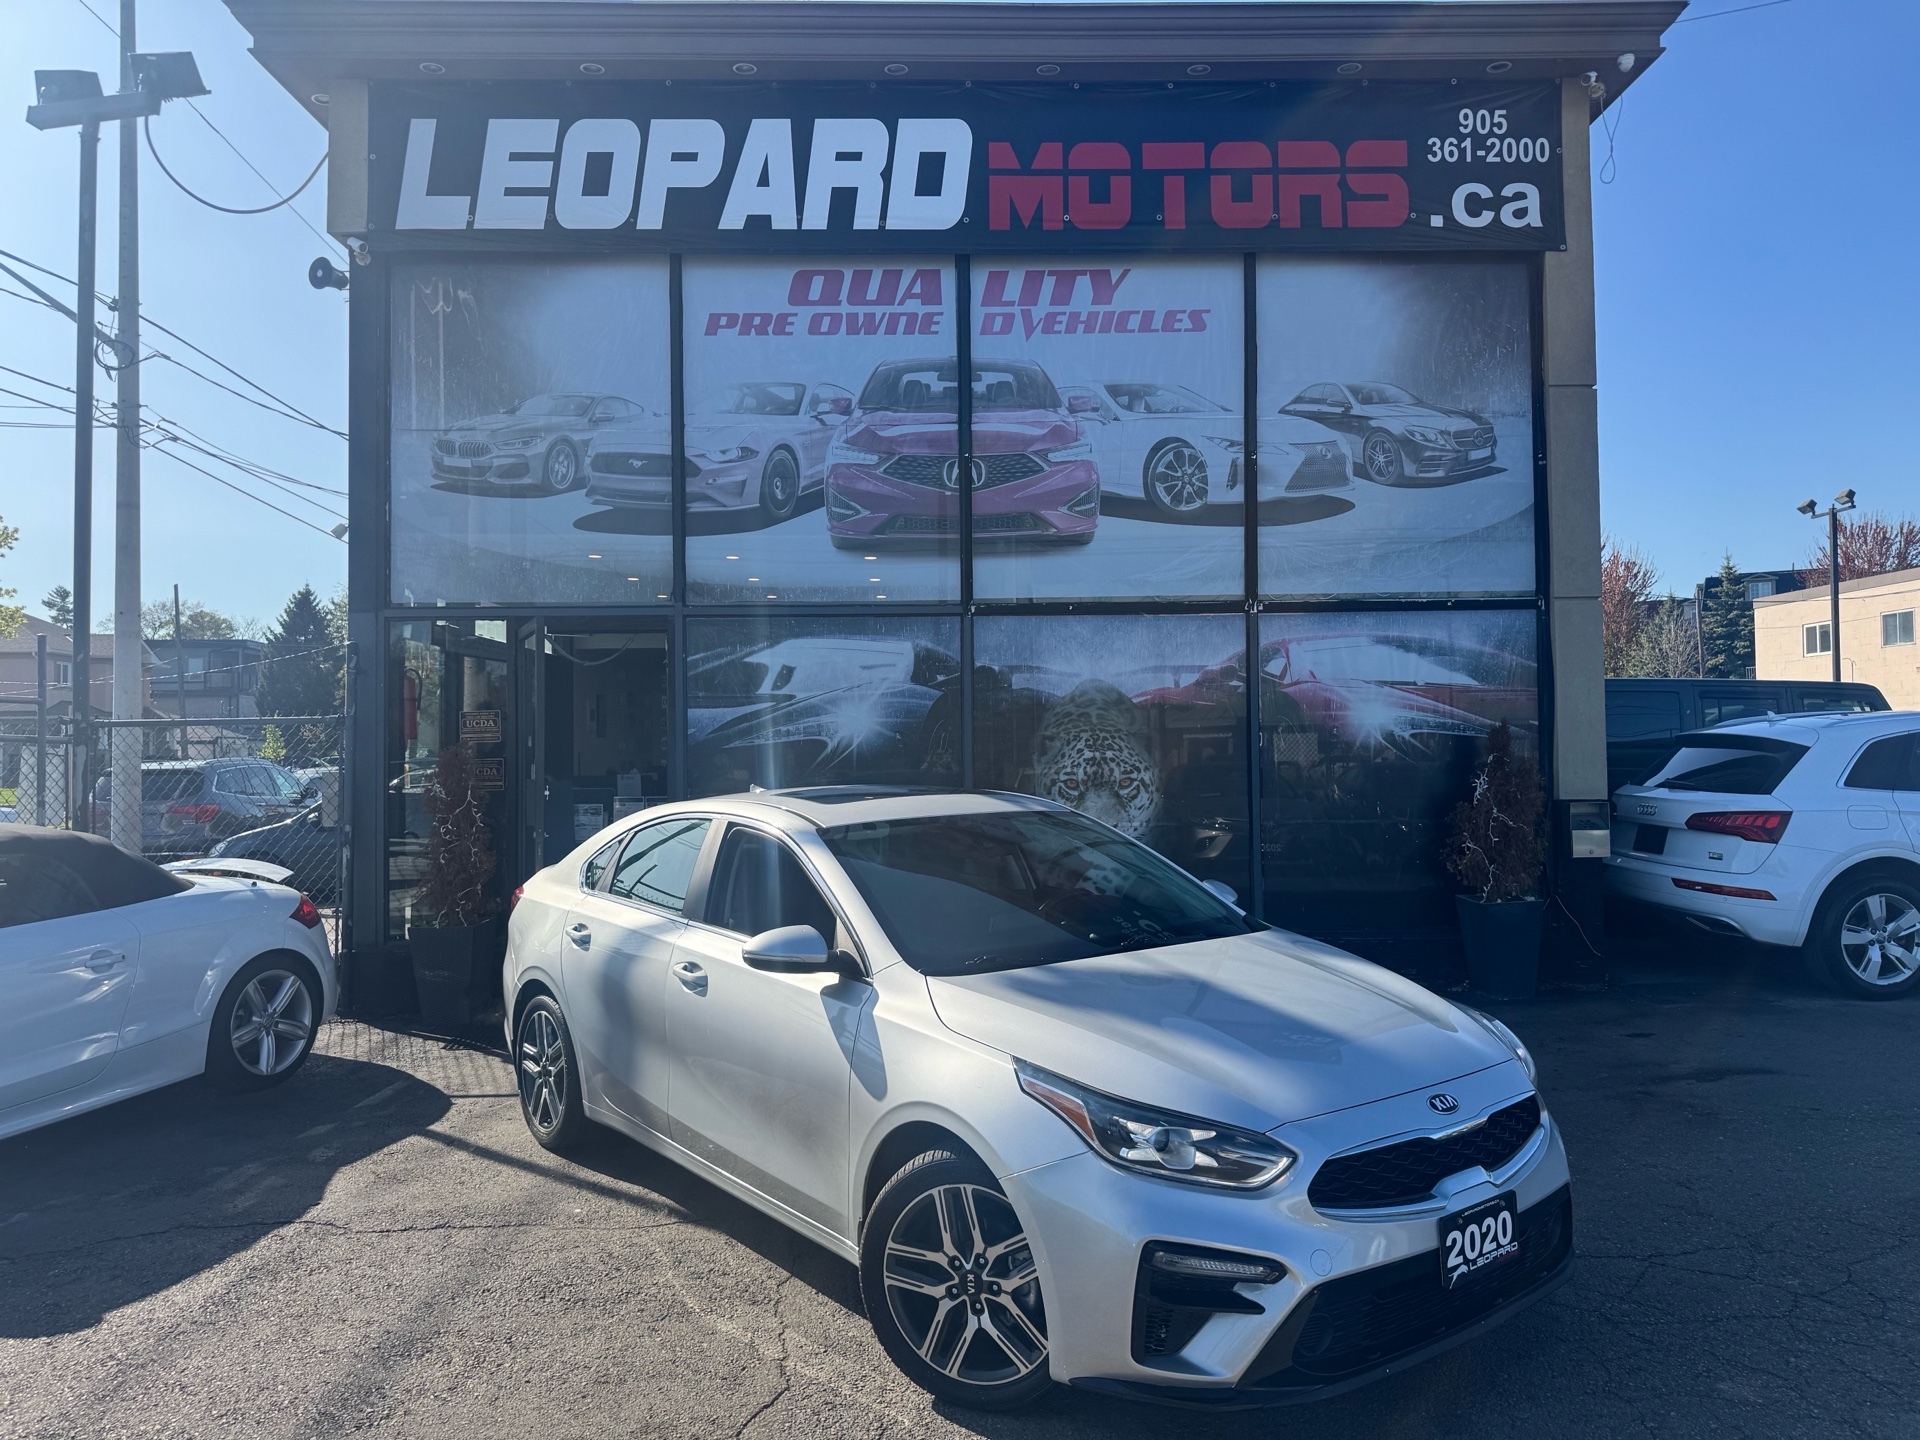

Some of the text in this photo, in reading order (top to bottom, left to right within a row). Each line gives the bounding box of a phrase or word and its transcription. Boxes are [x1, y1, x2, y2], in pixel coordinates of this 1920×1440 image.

[1458, 108, 1508, 134] 905
[1426, 137, 1550, 163] 361-2000
[395, 118, 1409, 230] LEOPARD MOTORS
[1430, 179, 1543, 228] .ca
[788, 268, 1131, 307] QUA LITY
[704, 312, 799, 336] PRE
[466, 719, 495, 728] UCDA
[1431, 1095, 1458, 1111] KIA
[1445, 1210, 1513, 1268] 2020
[1469, 1241, 1519, 1271] LEOPARD
[967, 1273, 975, 1294] KIA
